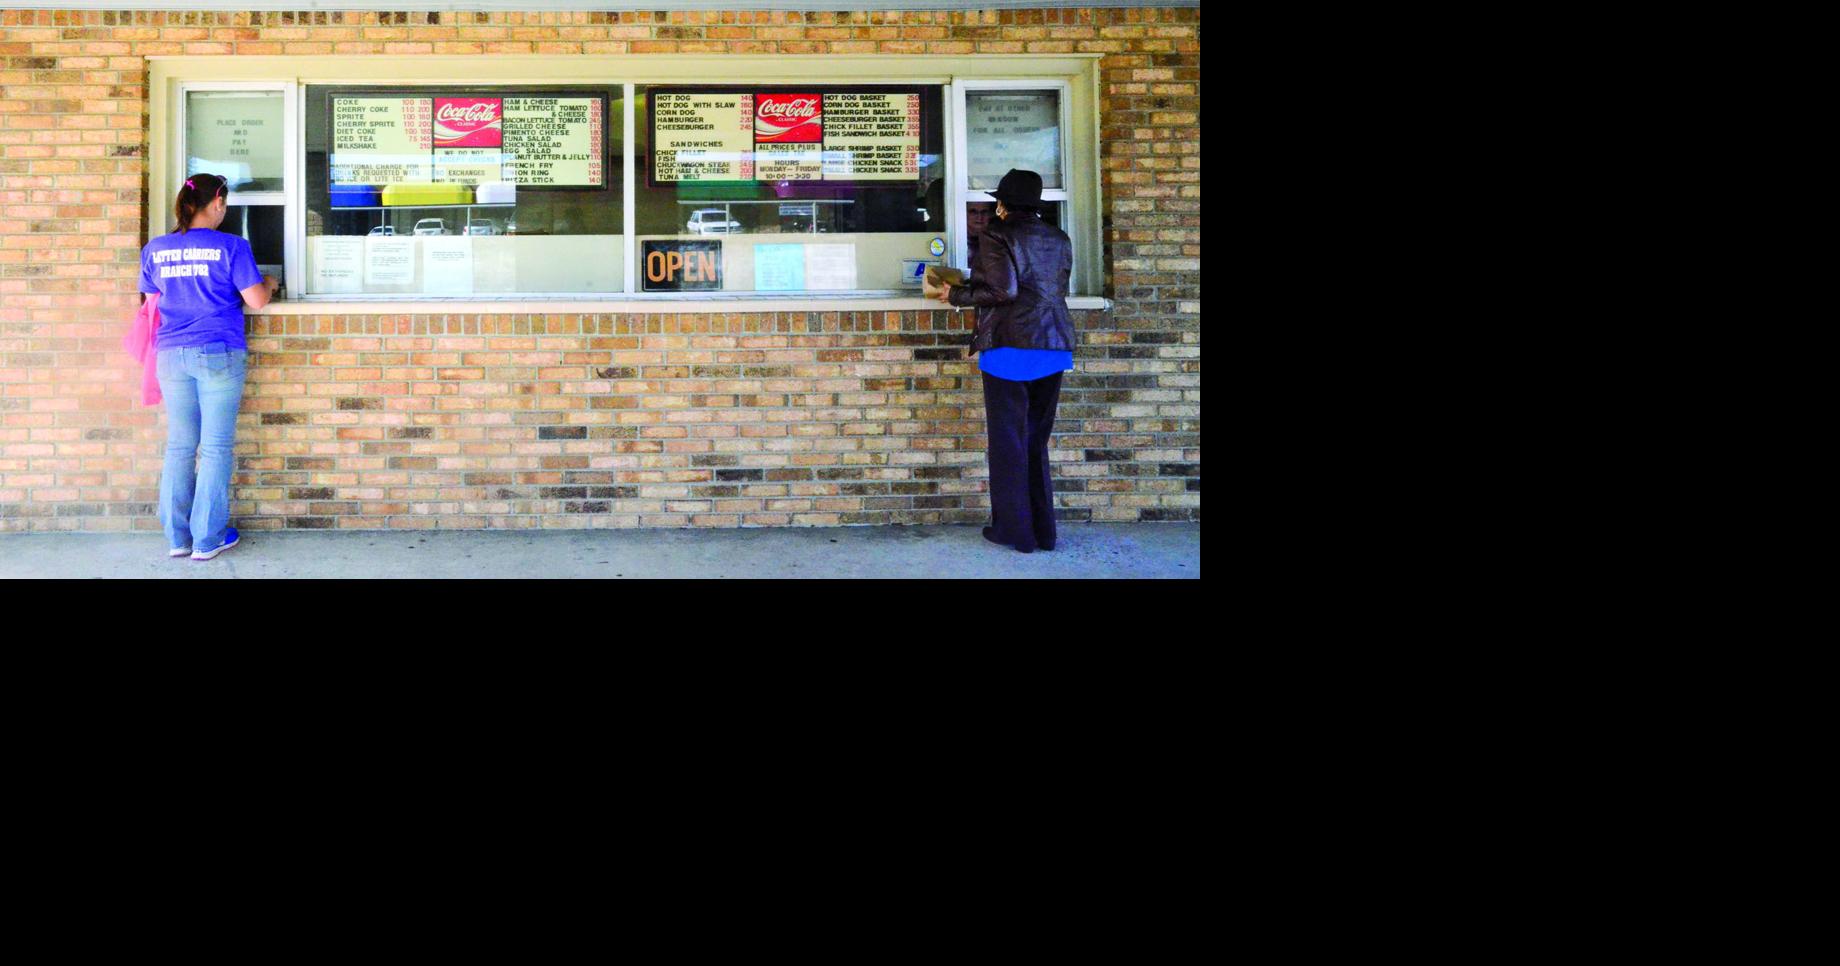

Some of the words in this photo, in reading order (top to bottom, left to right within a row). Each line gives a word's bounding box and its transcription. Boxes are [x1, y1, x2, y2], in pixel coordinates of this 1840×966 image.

[437, 103, 499, 122] Coca-Cola
[758, 99, 819, 117] Coca-Cola
[152, 249, 182, 264] LETTER
[183, 247, 221, 261] CARRIERS
[160, 264, 192, 278] BRANCH
[192, 264, 208, 276] 782
[648, 251, 716, 282] OPEN
